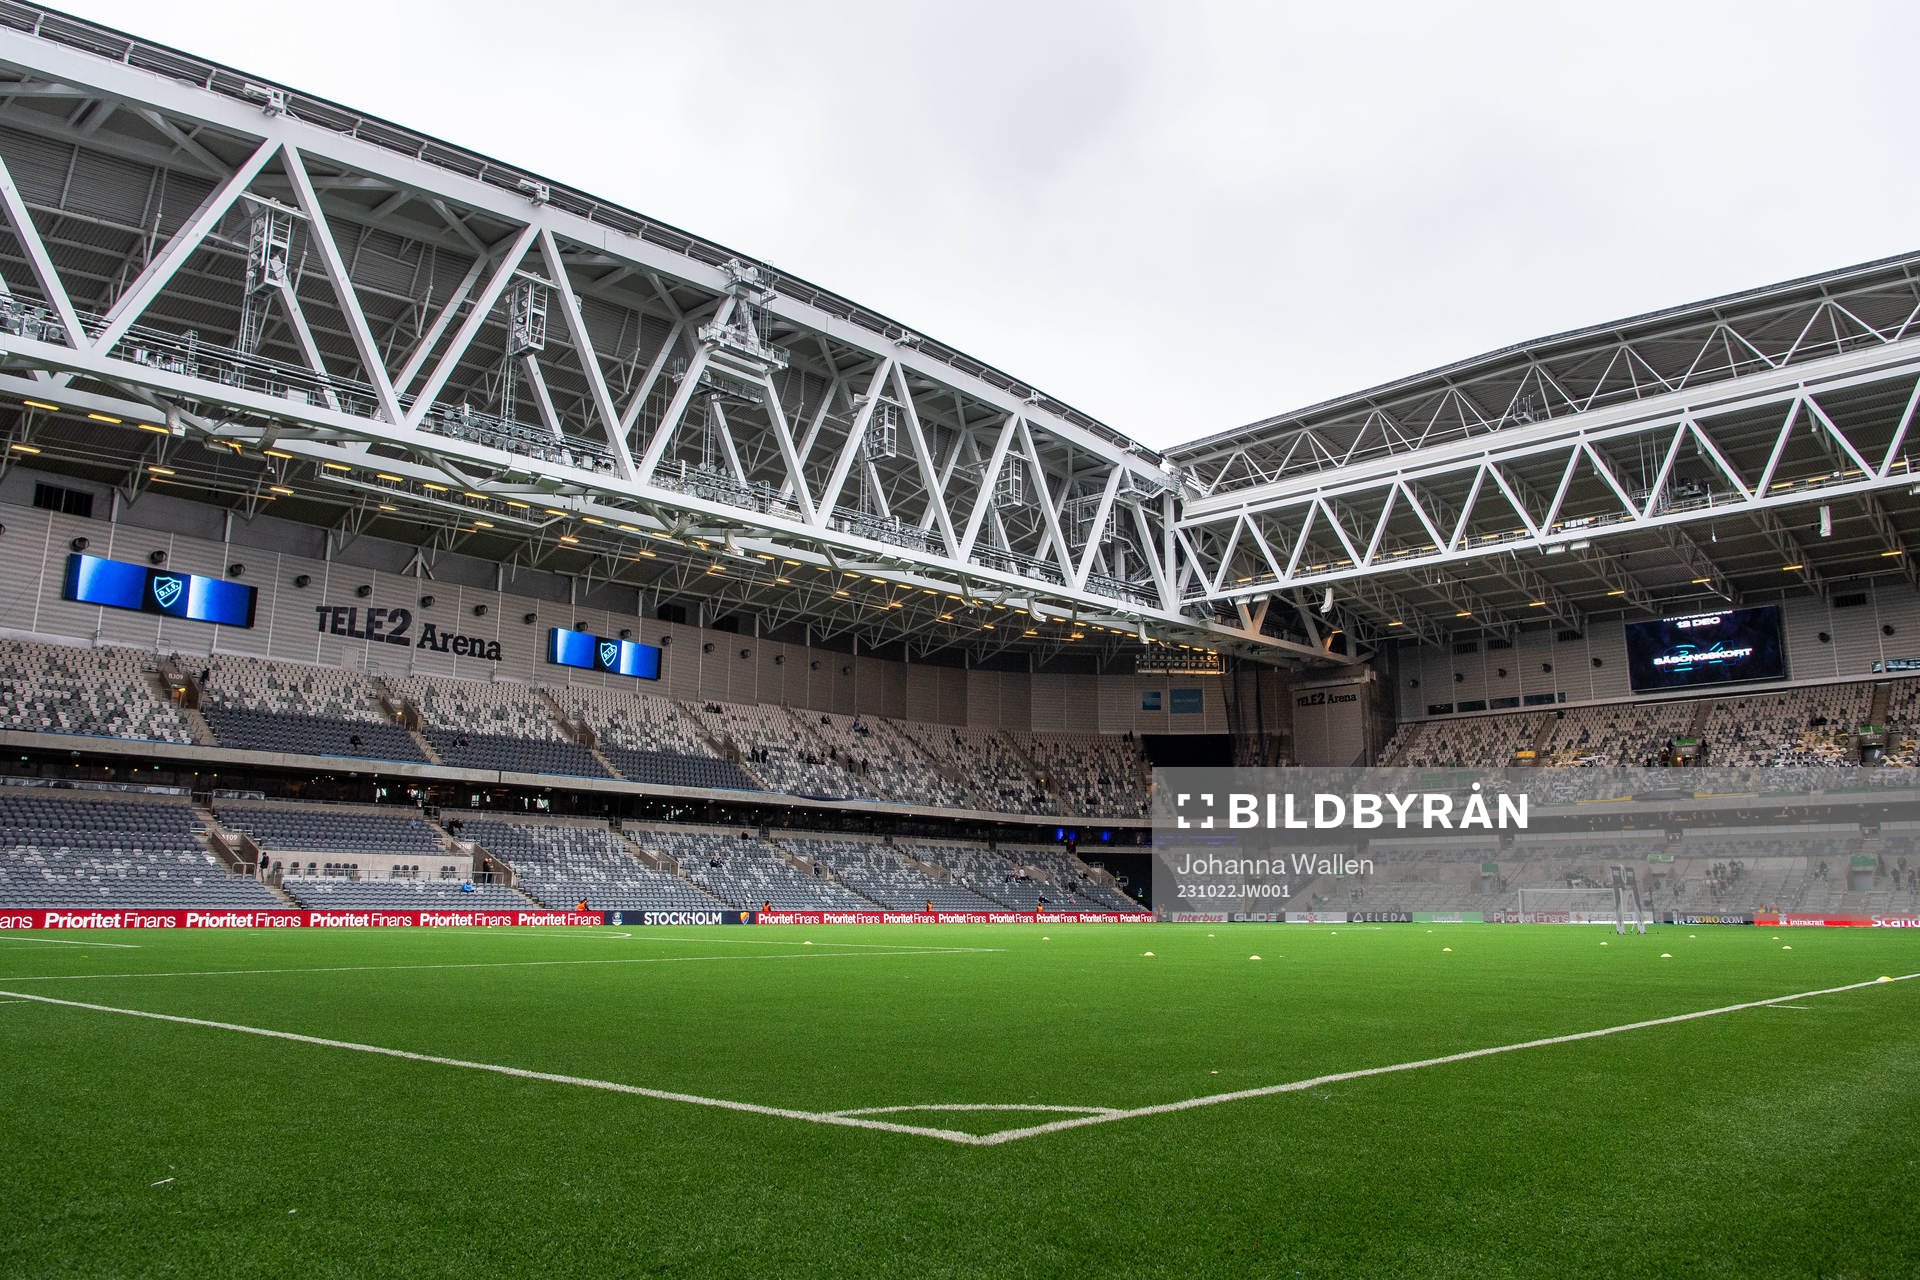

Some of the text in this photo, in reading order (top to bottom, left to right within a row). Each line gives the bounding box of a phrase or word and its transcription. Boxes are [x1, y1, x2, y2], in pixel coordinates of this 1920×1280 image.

[315, 605, 503, 662] TELE2 Arena
[1297, 692, 1357, 706] TELE2 Arena
[44, 912, 176, 928] Prioritet Finans
[186, 913, 301, 928] Prioritet Finans
[310, 912, 412, 927] Prioritet Finans
[420, 912, 511, 926] Prioritet Finans
[518, 912, 601, 926] Prioritet Finans
[644, 911, 722, 925] STOCKHOLM
[758, 913, 820, 924] Prioritet Finans
[823, 913, 880, 924] Prioritet Finans
[883, 913, 935, 923] Prioritet Finans
[1234, 913, 1277, 922] GUIDE
[1366, 912, 1408, 922] ELEDA
[1686, 915, 1744, 924] FXORO.COM
